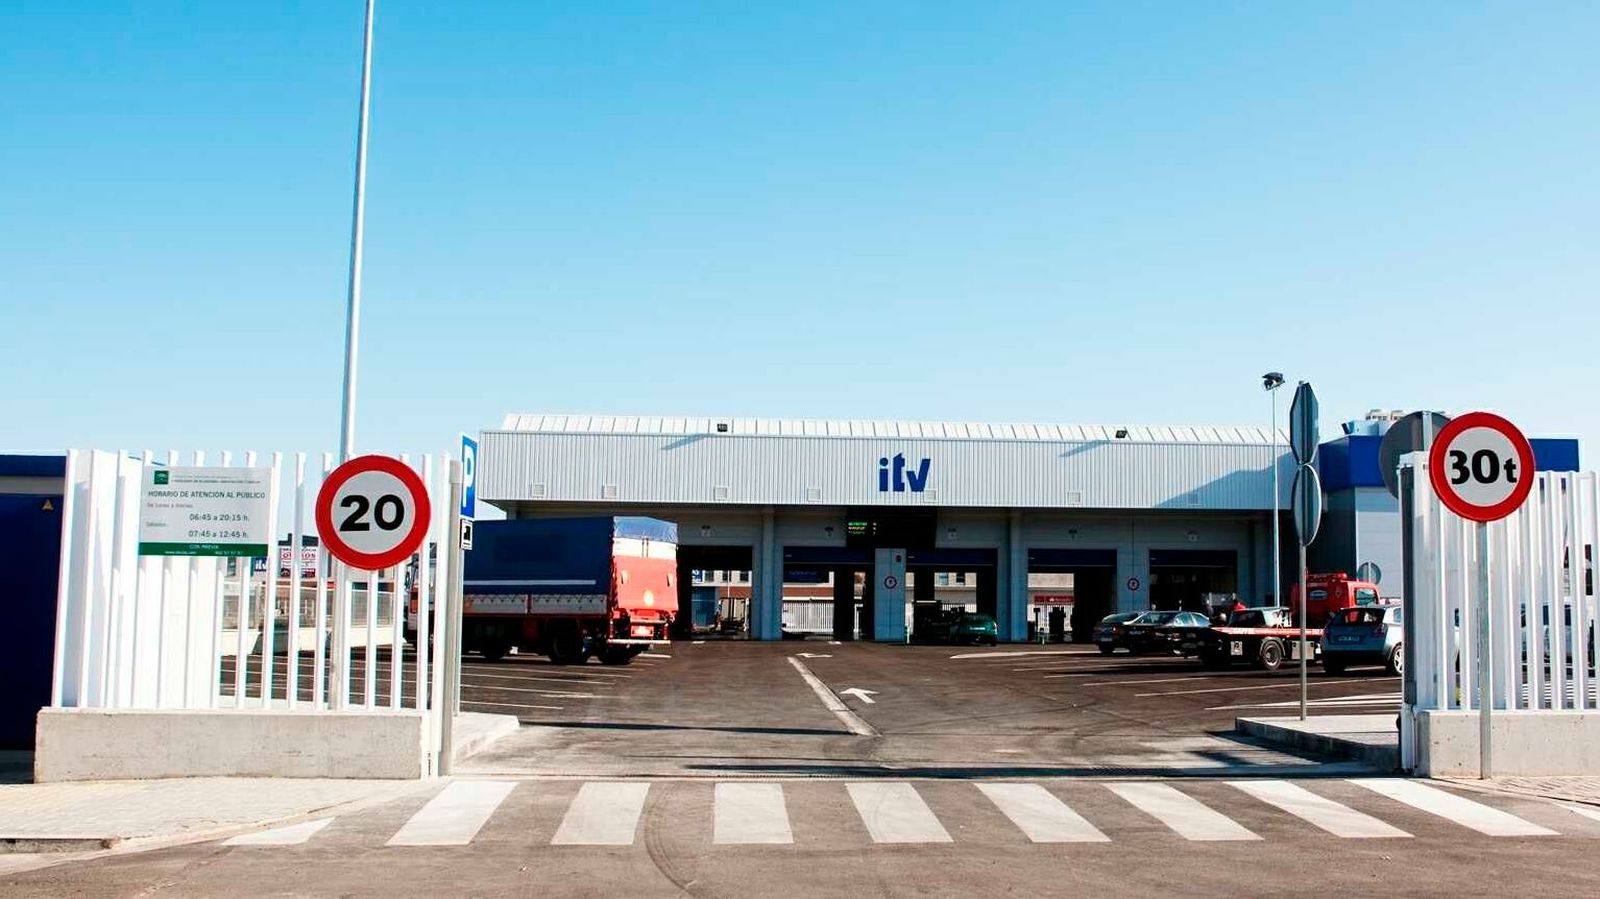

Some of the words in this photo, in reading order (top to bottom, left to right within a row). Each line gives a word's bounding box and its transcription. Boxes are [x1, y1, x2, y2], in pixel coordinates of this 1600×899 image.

[463, 443, 475, 508] P
[879, 452, 931, 492] itv
[148, 490, 179, 498] HORARIO
[180, 490, 190, 498] DE
[191, 489, 225, 499] ATENCIÓN
[226, 491, 235, 499] AL
[189, 513, 212, 521] 06:45
[219, 513, 242, 522] 20:15
[339, 494, 405, 532] 20
[188, 530, 211, 538] 07:45
[219, 530, 241, 538] 12:45
